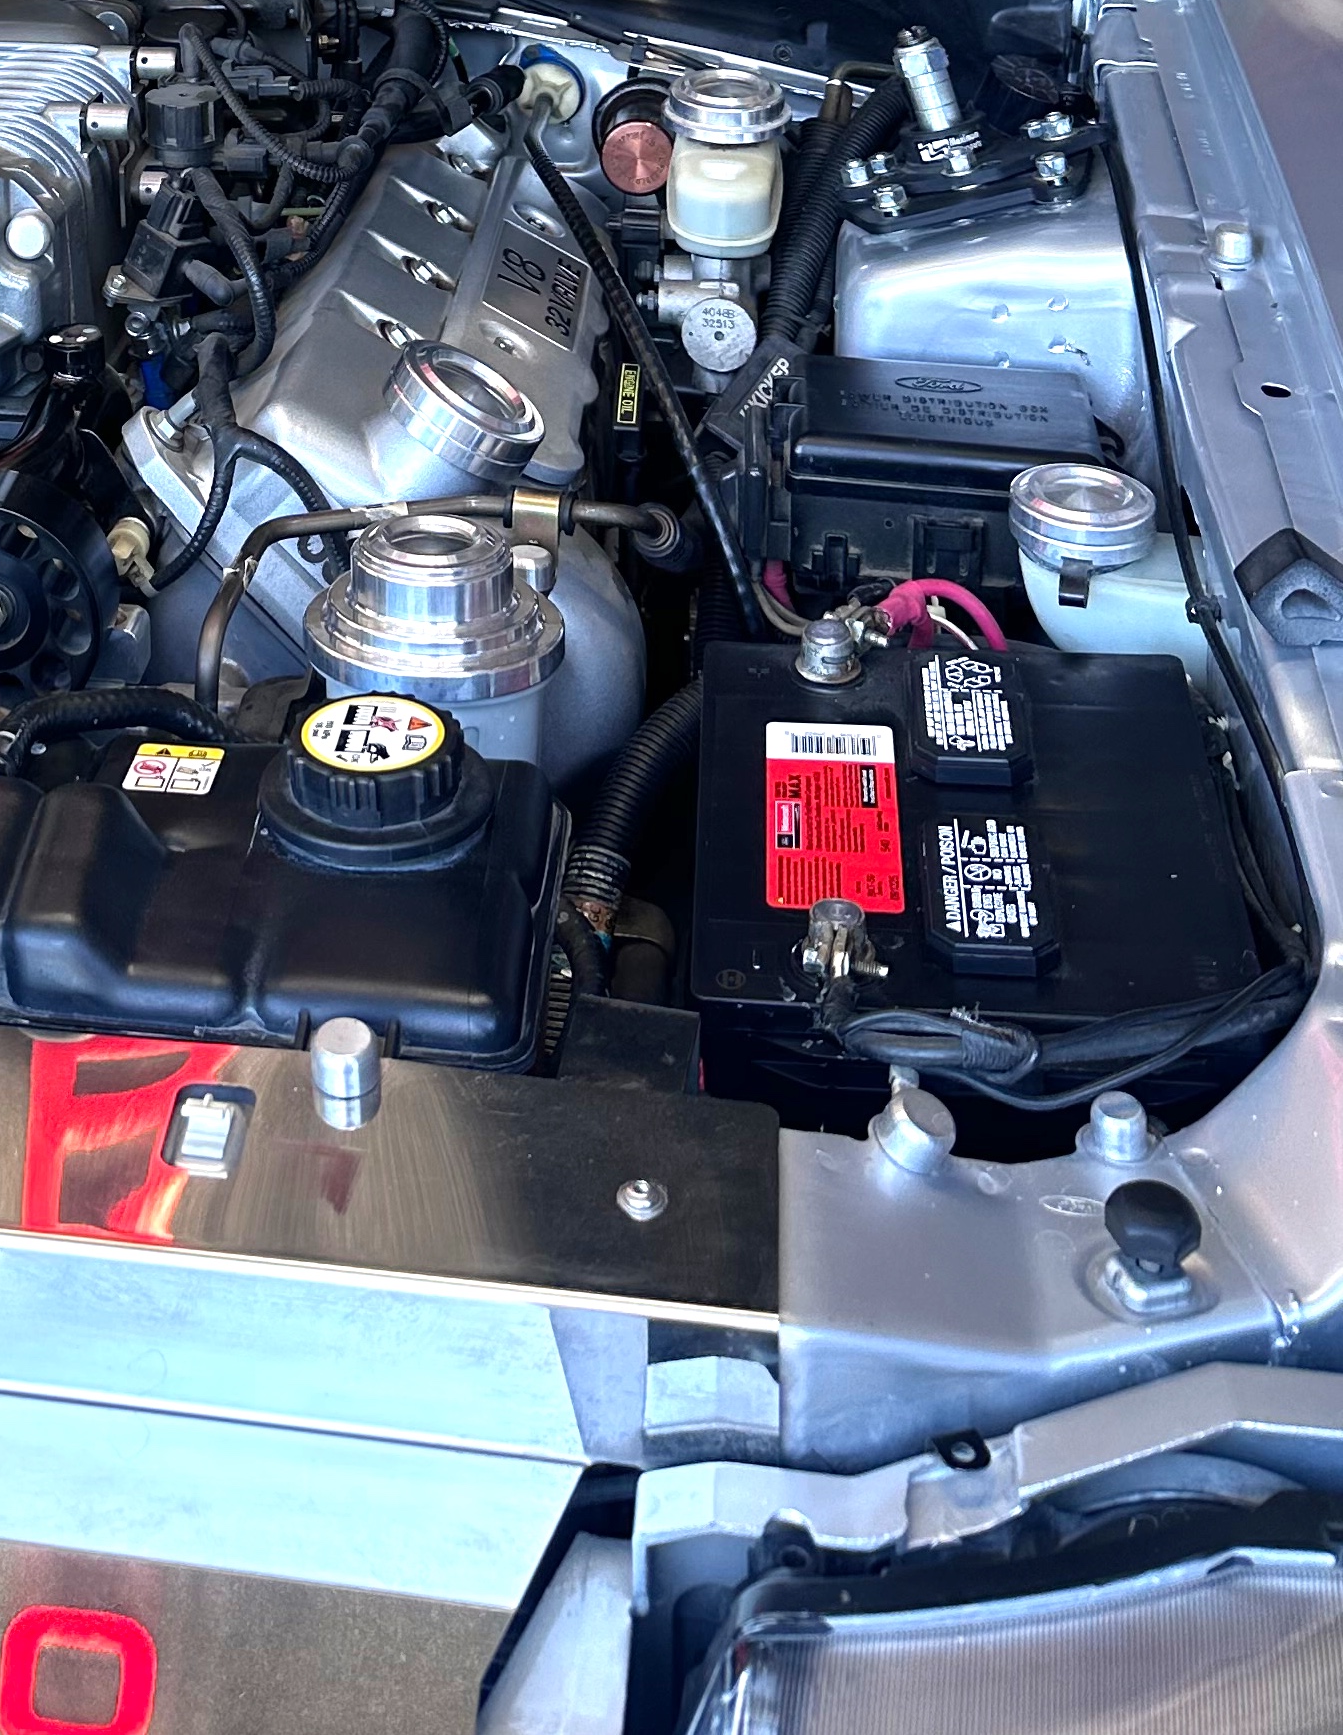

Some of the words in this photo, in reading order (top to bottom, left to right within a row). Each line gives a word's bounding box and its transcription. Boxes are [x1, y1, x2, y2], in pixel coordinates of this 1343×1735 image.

[497, 247, 547, 295] V8
[548, 258, 582, 312] VALVE
[544, 305, 573, 336] 32
[622, 370, 637, 398] ENGINE
[621, 399, 633, 414] OIL
[903, 395, 1009, 412] DISTRIBUTION
[787, 774, 802, 798] MAX
[937, 825, 956, 865] POISON
[942, 875, 961, 921] DANGER
